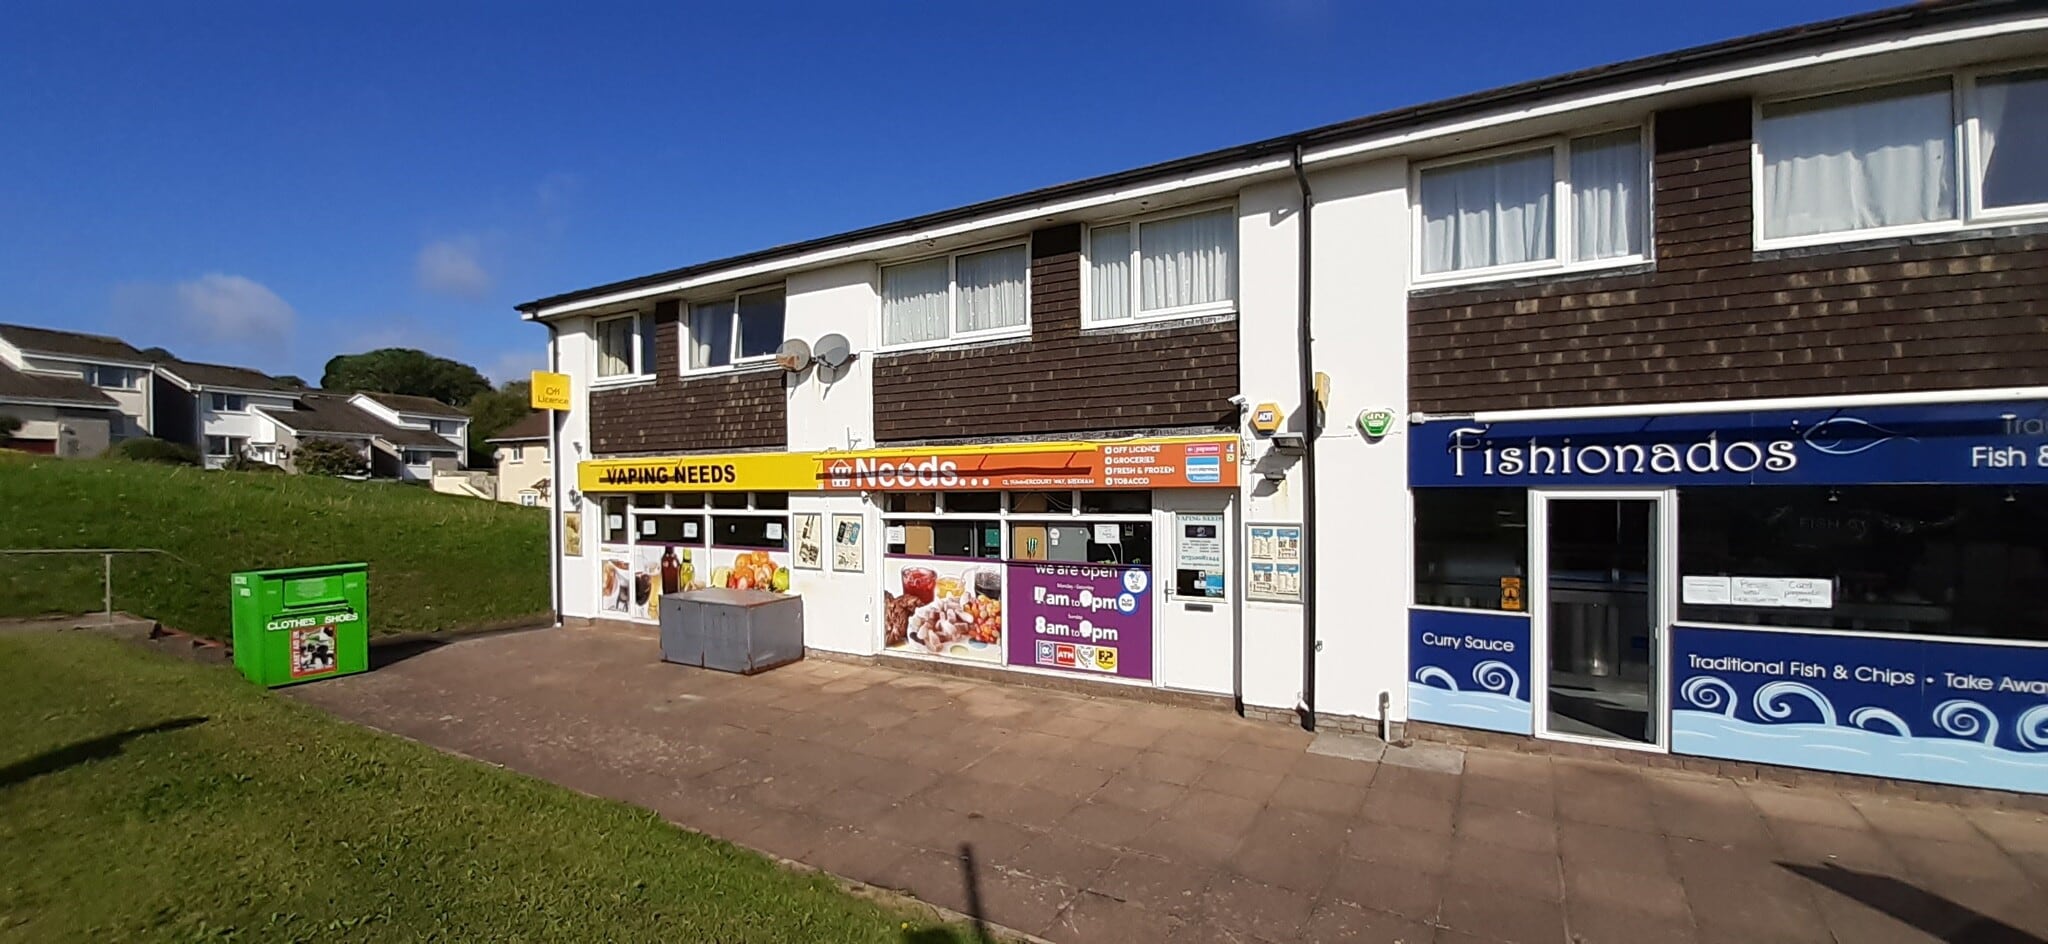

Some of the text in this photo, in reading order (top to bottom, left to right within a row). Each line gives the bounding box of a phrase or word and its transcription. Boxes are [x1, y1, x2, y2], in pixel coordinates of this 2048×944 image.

[537, 394, 569, 405] Licence
[545, 386, 561, 396] Off
[1258, 411, 1273, 423] ADT
[2000, 413, 2048, 435] Tra
[1112, 445, 1161, 454] OFF LICENCE
[1448, 424, 1798, 477] Fishionados
[1972, 445, 2027, 468] Fish
[606, 464, 737, 486] VAPING NEEDS
[1113, 467, 1136, 475] FRESH
[1144, 466, 1175, 474] FROZEN
[1057, 565, 1078, 576] are
[1081, 566, 1117, 580] open
[1071, 599, 1080, 607] to
[267, 613, 358, 631] CLOTHES SHOES
[1035, 616, 1070, 637] 8am
[1071, 629, 1080, 638] to
[1422, 631, 1515, 652] Curry Sauce
[1688, 653, 2048, 694] Traditional Fish & Chips Take Awa
